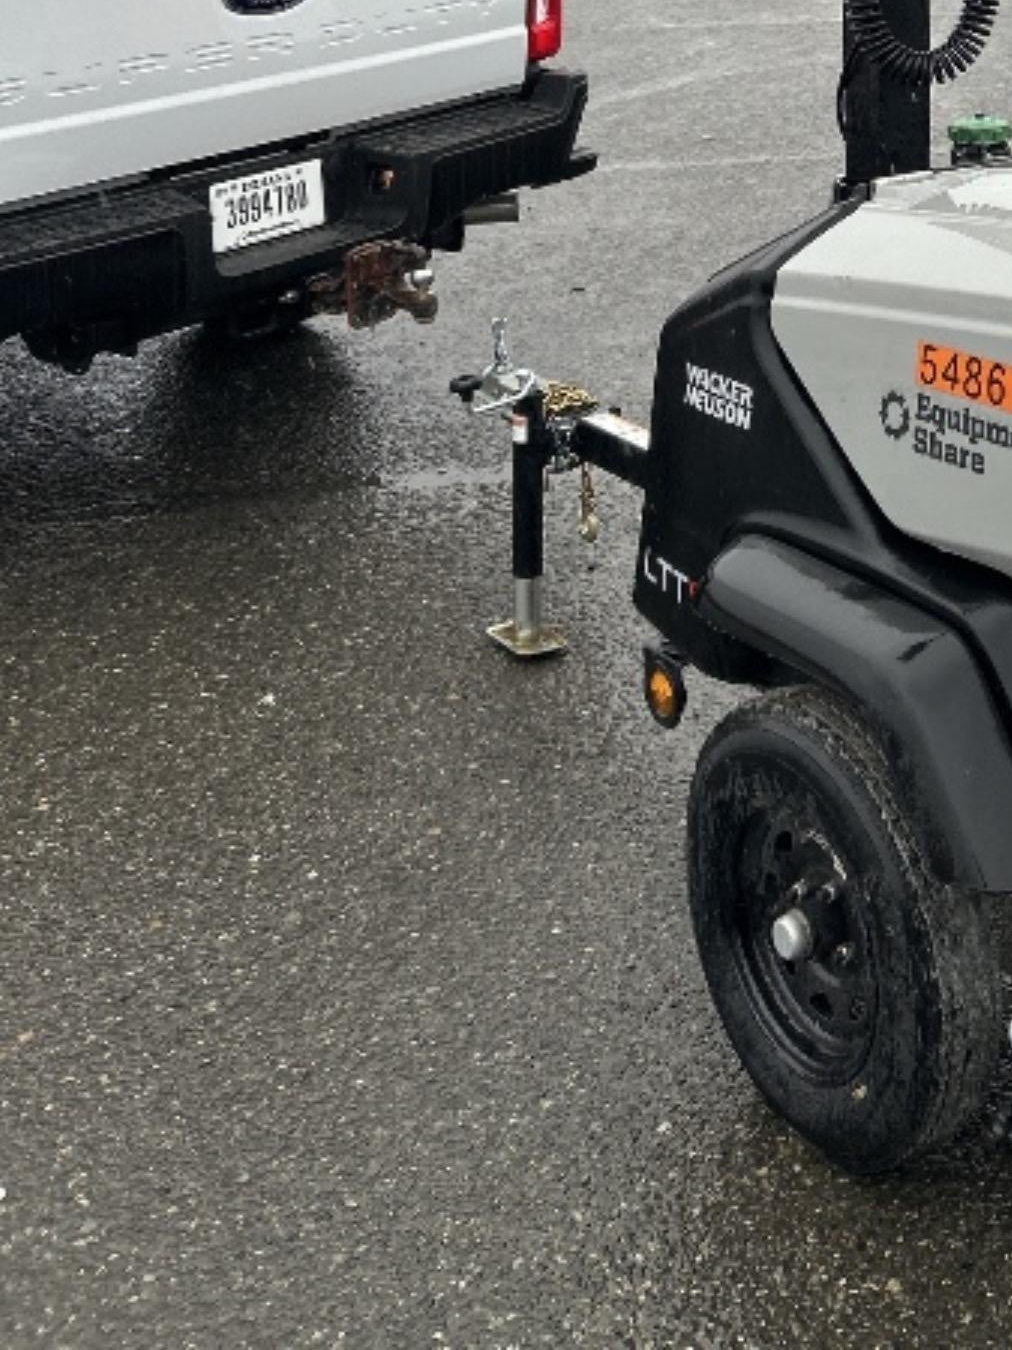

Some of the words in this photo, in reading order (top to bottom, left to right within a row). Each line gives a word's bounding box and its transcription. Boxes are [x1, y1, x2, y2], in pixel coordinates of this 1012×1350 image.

[682, 382, 752, 430] NEUSON
[685, 361, 754, 410] WACKER
[912, 425, 986, 475] Share
